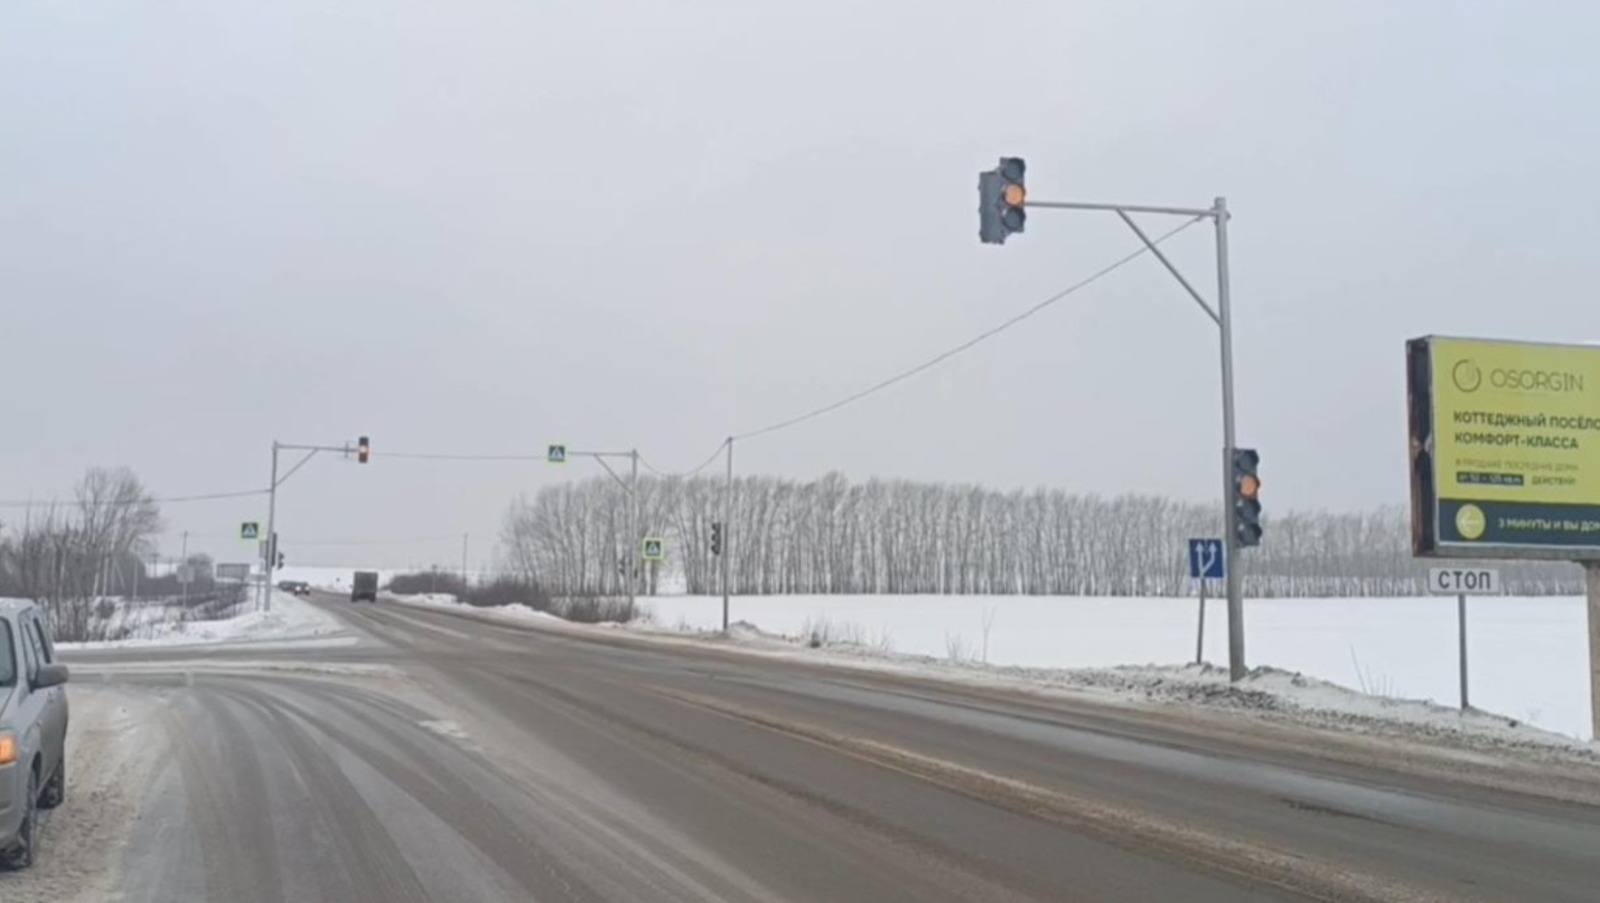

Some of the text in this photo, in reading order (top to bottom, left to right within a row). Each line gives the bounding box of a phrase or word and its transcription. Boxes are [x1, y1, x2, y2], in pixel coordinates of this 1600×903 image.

[1490, 368, 1583, 391] OSORGIN
[1454, 411, 1546, 428] КОТТЕДЖНЫЙ
[1454, 432, 1578, 449] КОМФОРТ-КЛАССА
[1506, 518, 1552, 530] МИНУТЫ
[1553, 520, 1561, 530] И
[1563, 520, 1579, 531] ВЫ
[1438, 571, 1491, 590] СТОП
